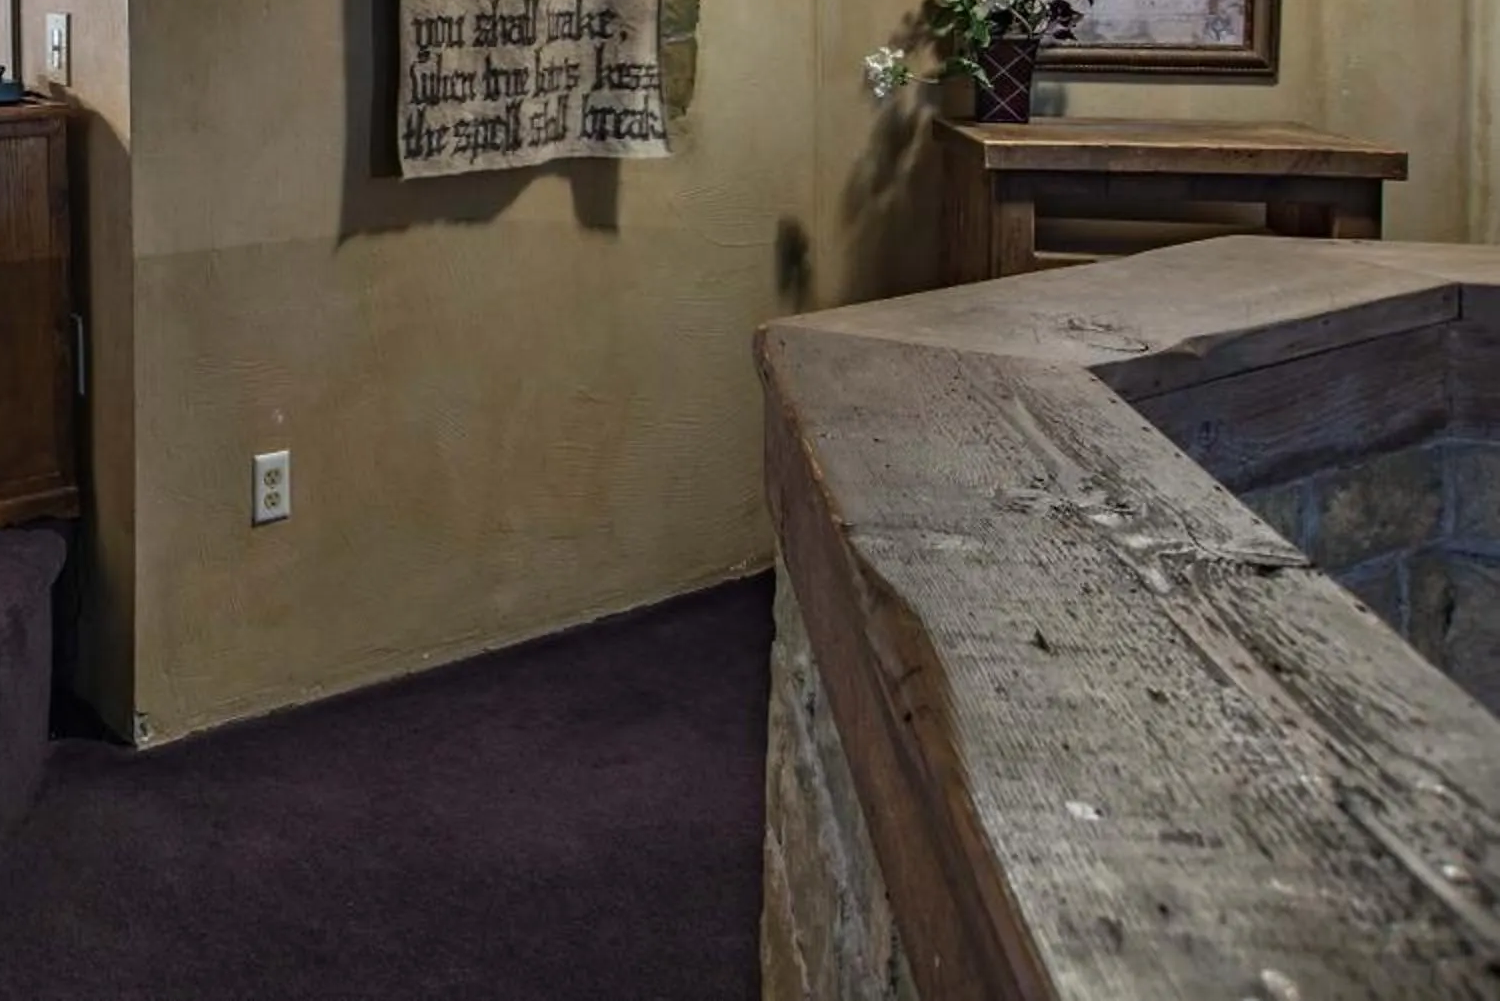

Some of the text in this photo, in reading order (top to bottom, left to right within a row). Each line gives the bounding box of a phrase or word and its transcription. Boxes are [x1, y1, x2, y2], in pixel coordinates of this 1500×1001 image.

[411, 13, 465, 63] you
[410, 53, 476, 104] when
[403, 103, 451, 160] the
[450, 99, 522, 165] spell
